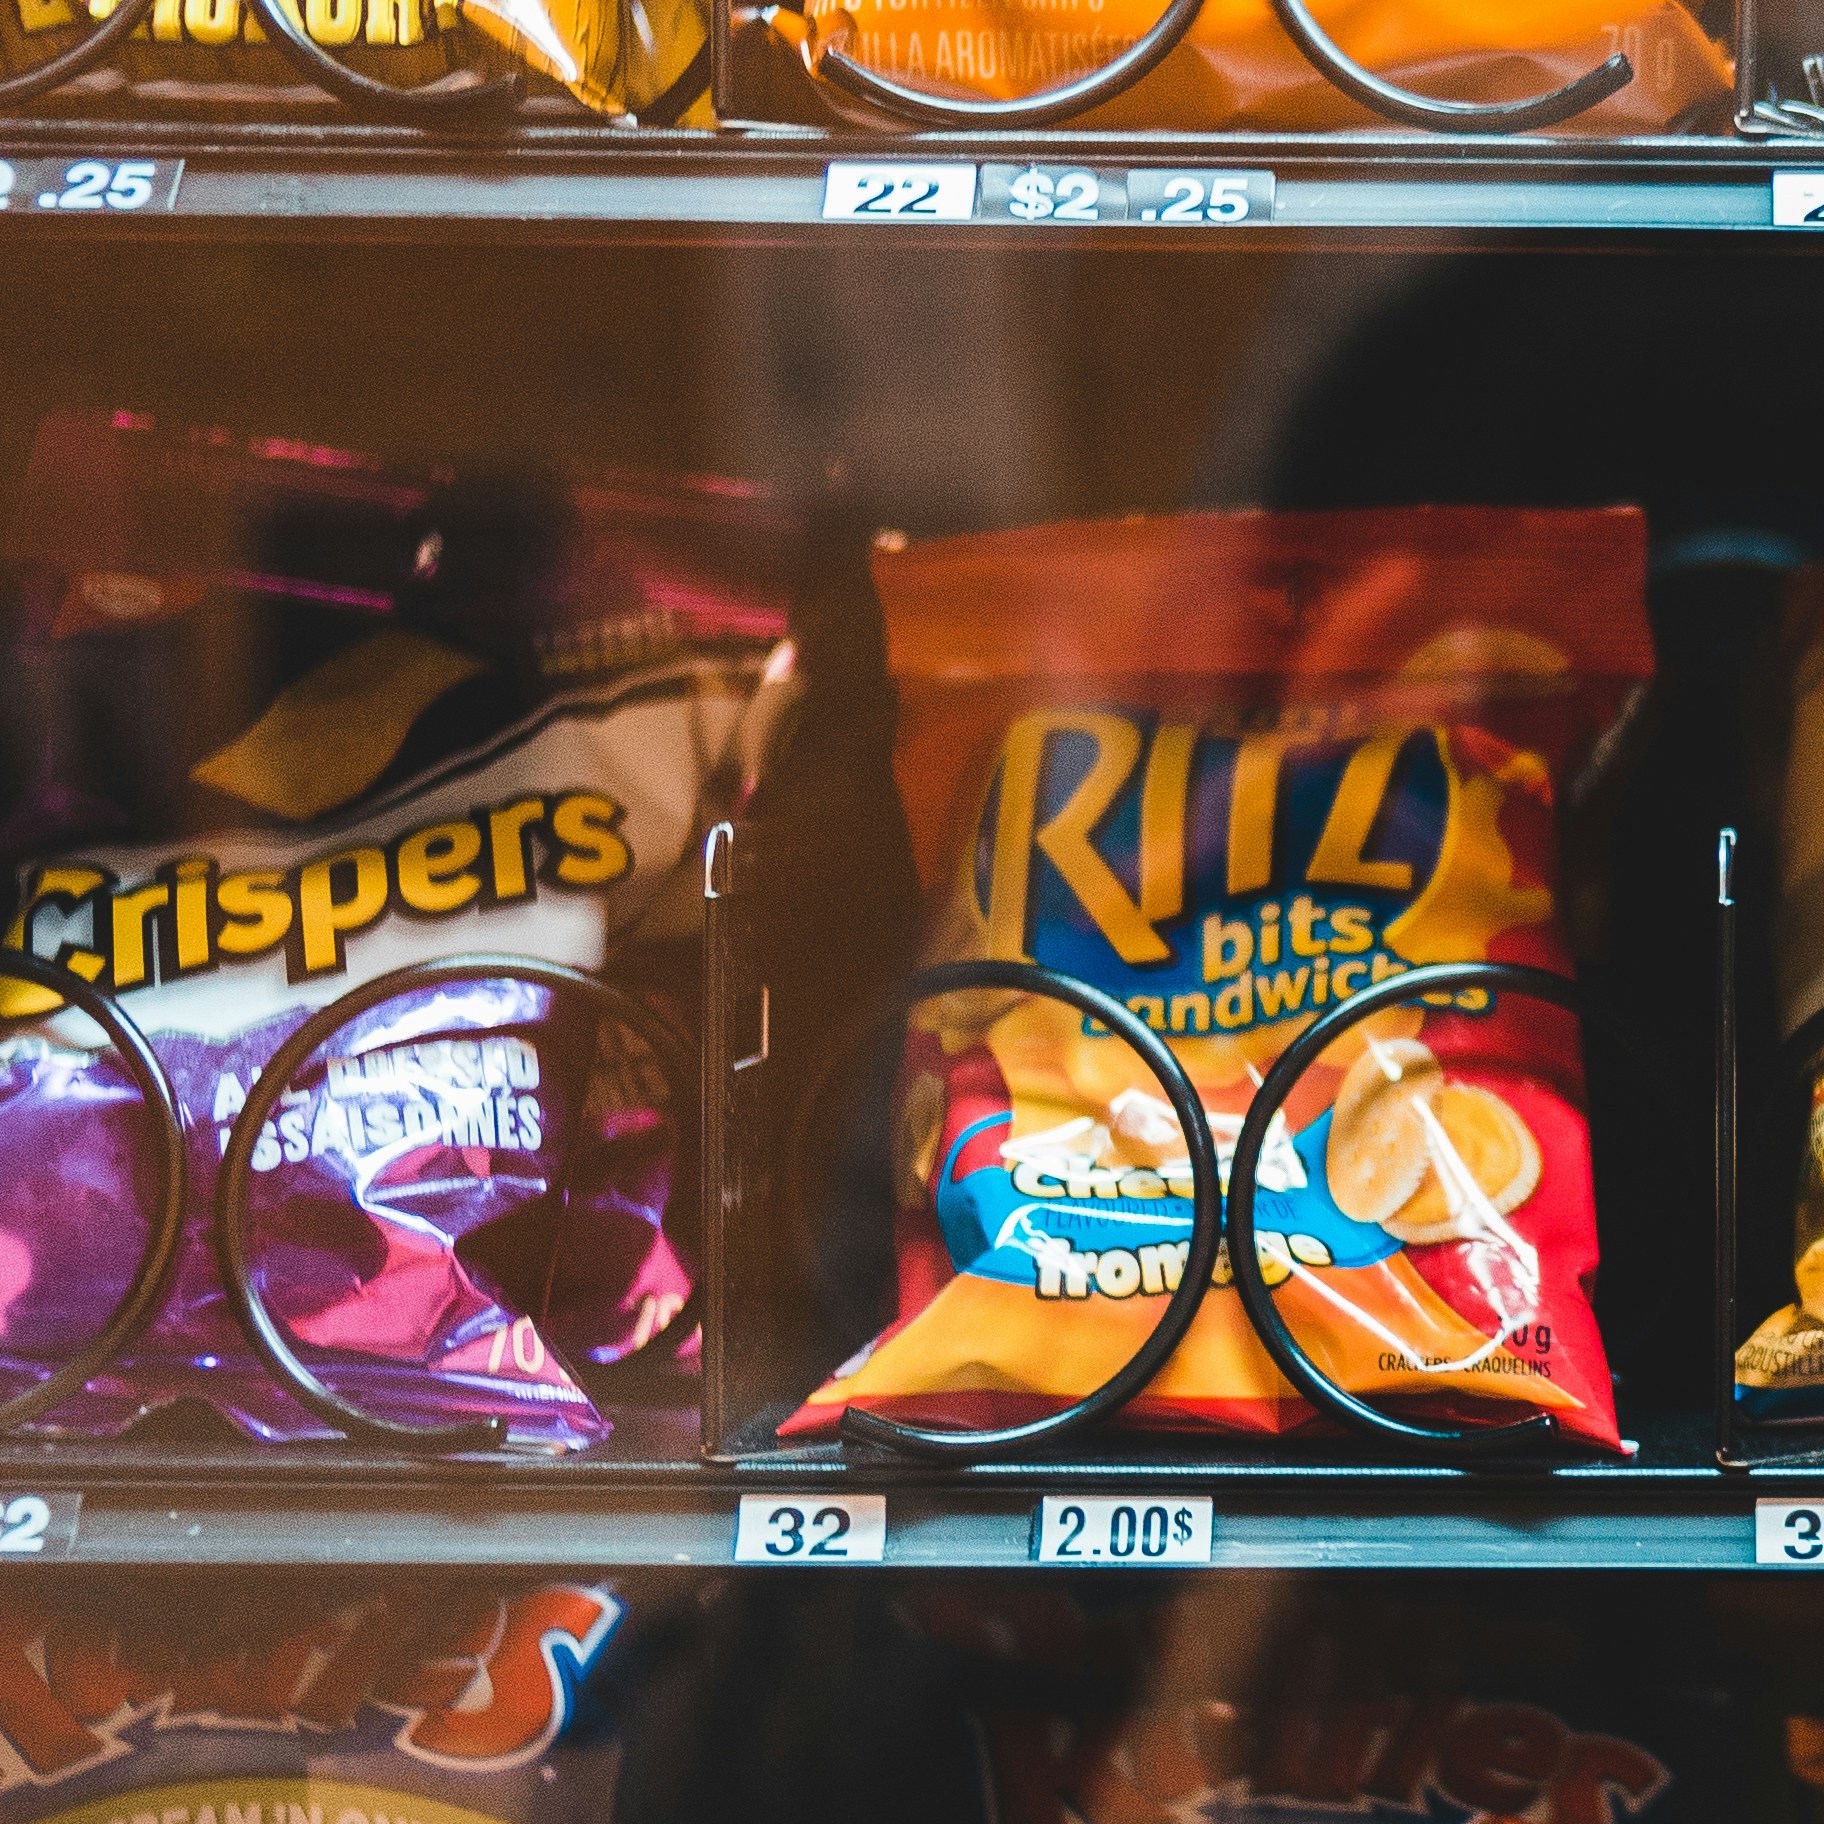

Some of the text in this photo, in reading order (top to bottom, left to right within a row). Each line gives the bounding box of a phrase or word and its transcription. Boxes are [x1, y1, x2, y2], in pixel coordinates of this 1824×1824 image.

[38, 161, 157, 210] .25
[854, 175, 939, 215] 22
[1008, 166, 1250, 223] $2 .25
[987, 706, 1418, 965] RITZ
[1201, 894, 1376, 984] bits
[1534, 1322, 1553, 1355] g
[763, 1506, 853, 1557] 32
[1057, 1504, 1195, 1560] 2.00$
